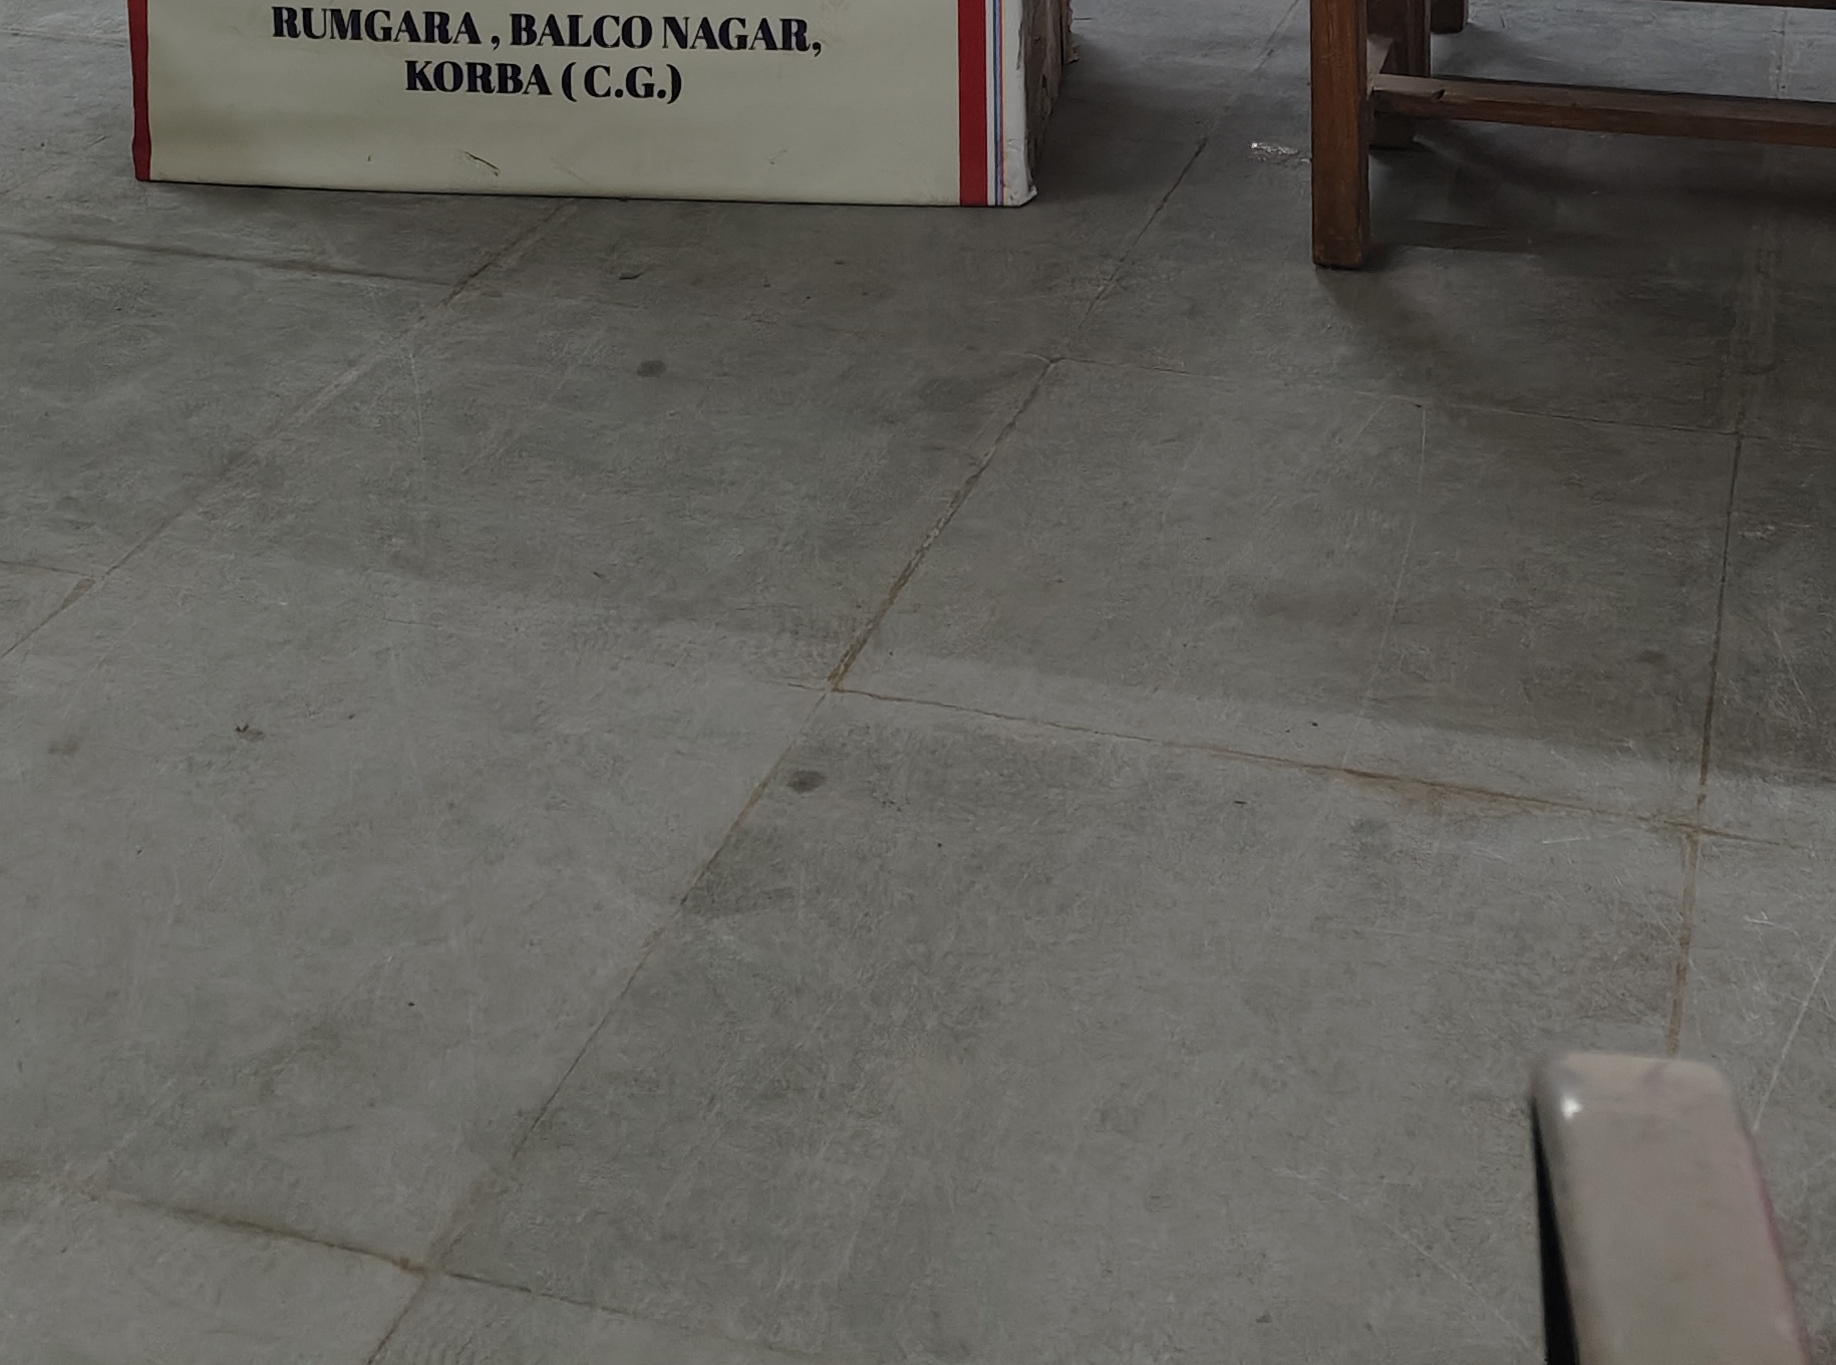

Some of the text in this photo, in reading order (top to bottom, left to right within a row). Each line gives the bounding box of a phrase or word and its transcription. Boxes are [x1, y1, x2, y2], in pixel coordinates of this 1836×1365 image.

[510, 12, 653, 49] BALCO
[661, 15, 824, 58] NAGAR,
[405, 59, 552, 96] KORBA
